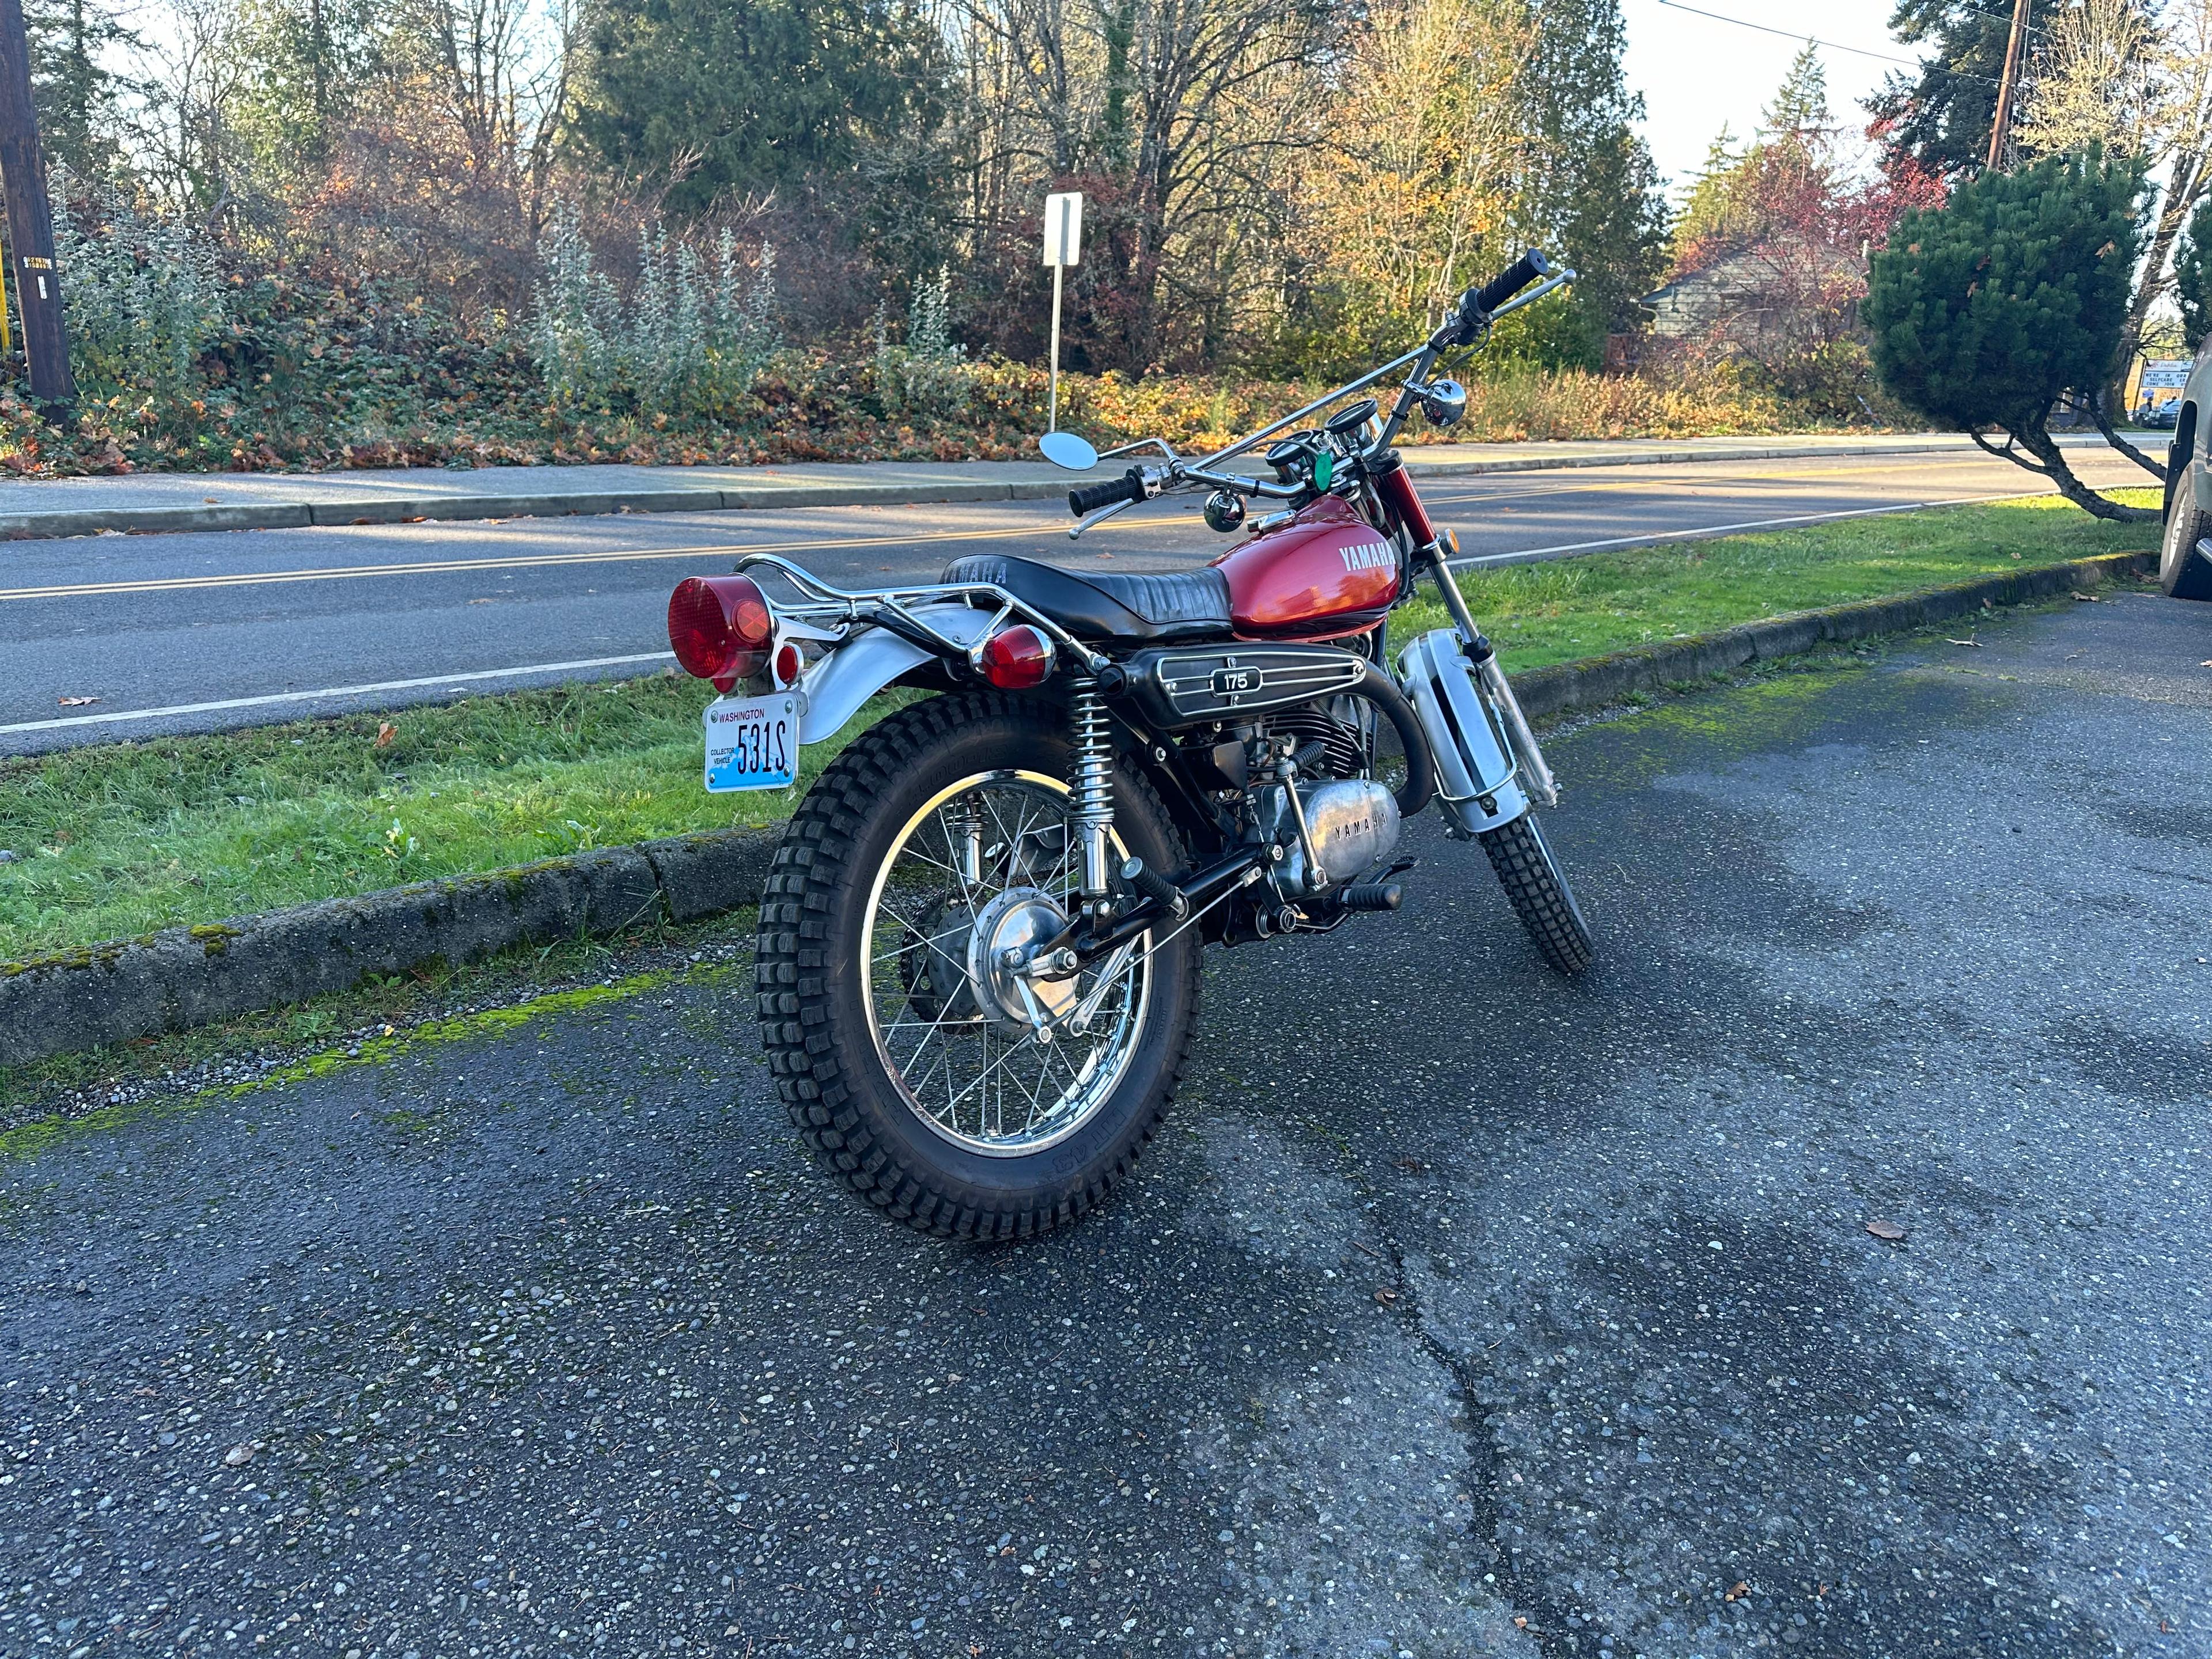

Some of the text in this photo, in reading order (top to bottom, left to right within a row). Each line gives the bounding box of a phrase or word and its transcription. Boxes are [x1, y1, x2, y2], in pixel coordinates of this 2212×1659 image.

[1339, 542, 1396, 571] YAMAHA
[944, 562, 1007, 584] YAMAHA
[1224, 673, 1248, 690] 175
[719, 708, 765, 723] WASHINGTON
[710, 747, 734, 756] COLLECTOR
[737, 720, 786, 774] 531S
[1335, 813, 1387, 841] YAMAHA
